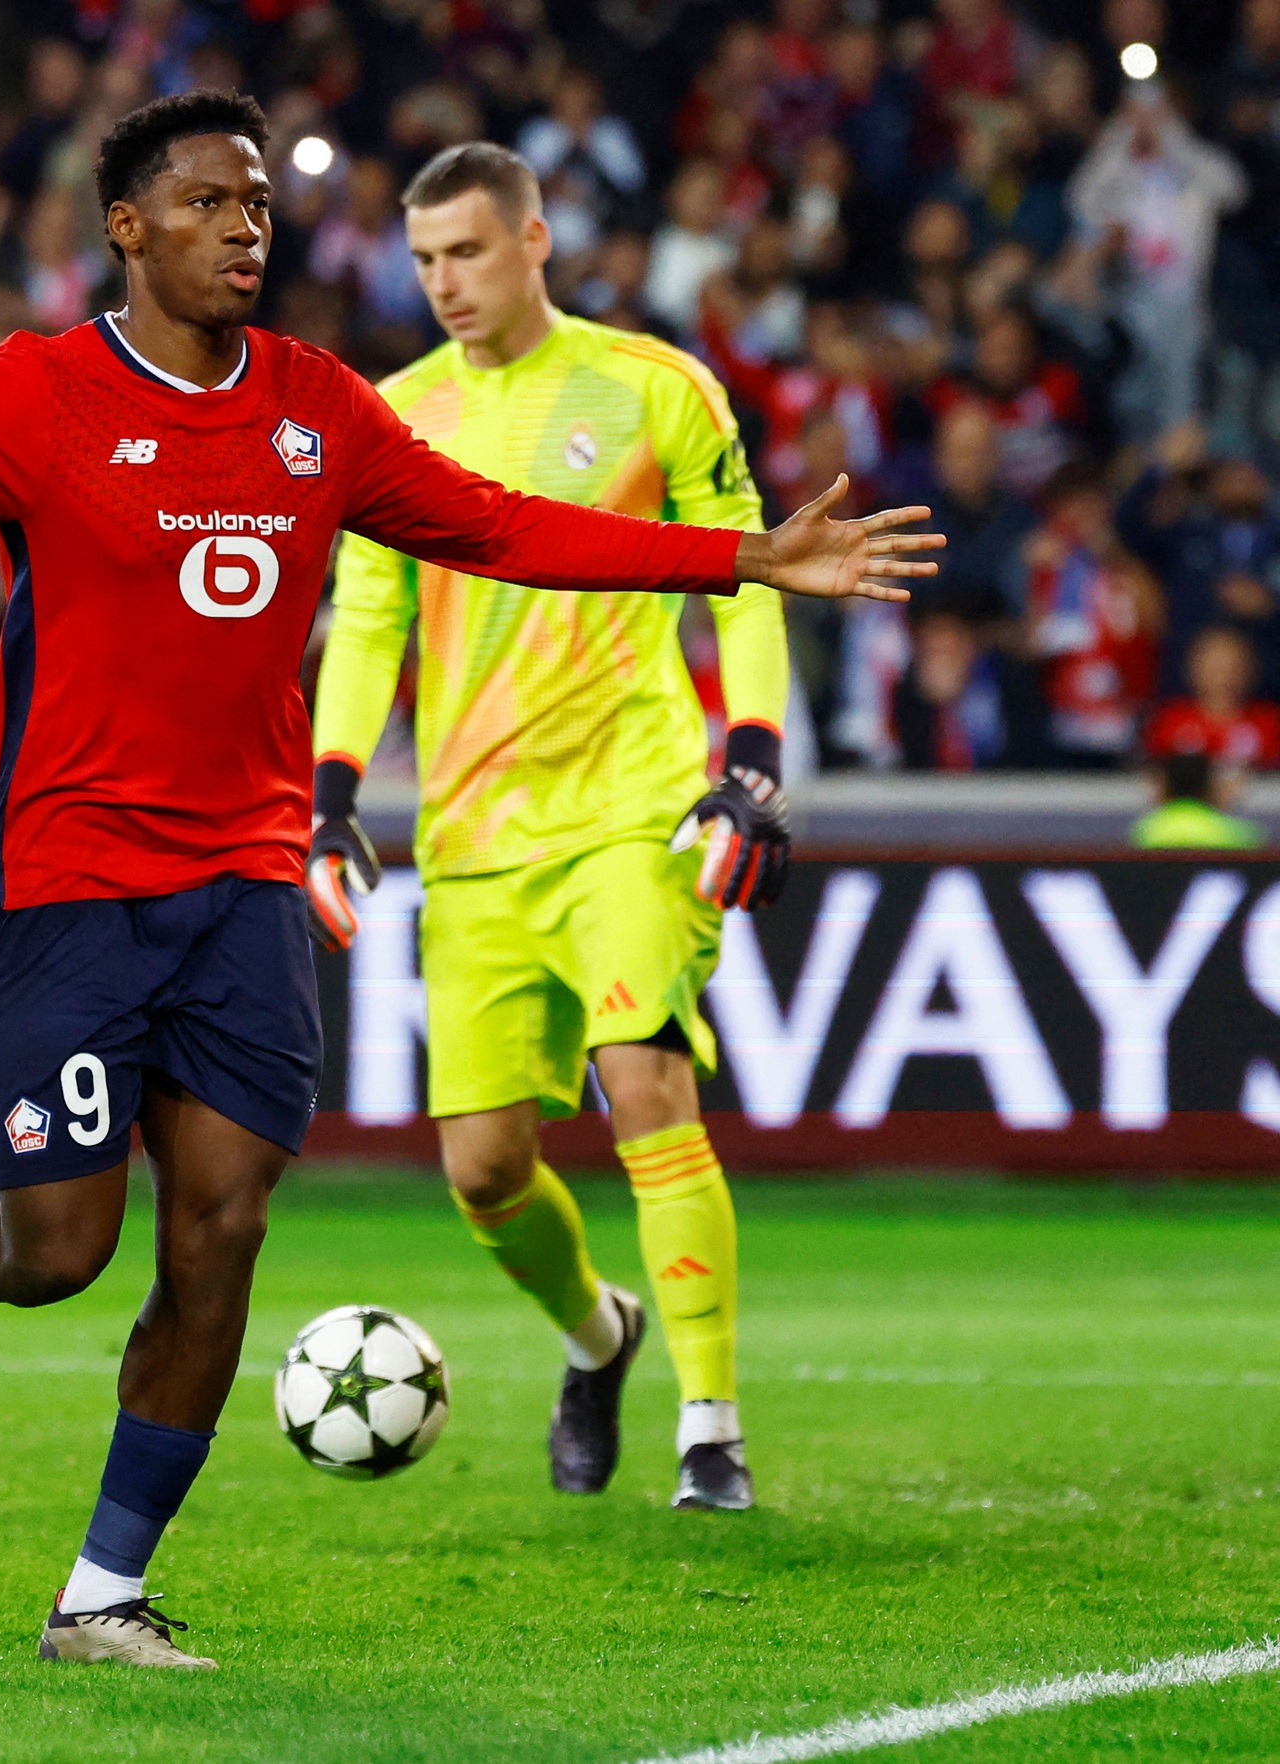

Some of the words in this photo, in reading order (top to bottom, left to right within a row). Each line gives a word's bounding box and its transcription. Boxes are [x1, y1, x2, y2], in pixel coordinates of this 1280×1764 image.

[290, 459, 317, 472] LOSC
[157, 509, 297, 536] boulanger
[60, 1052, 110, 1147] 9
[16, 1135, 42, 1150] LOSC
